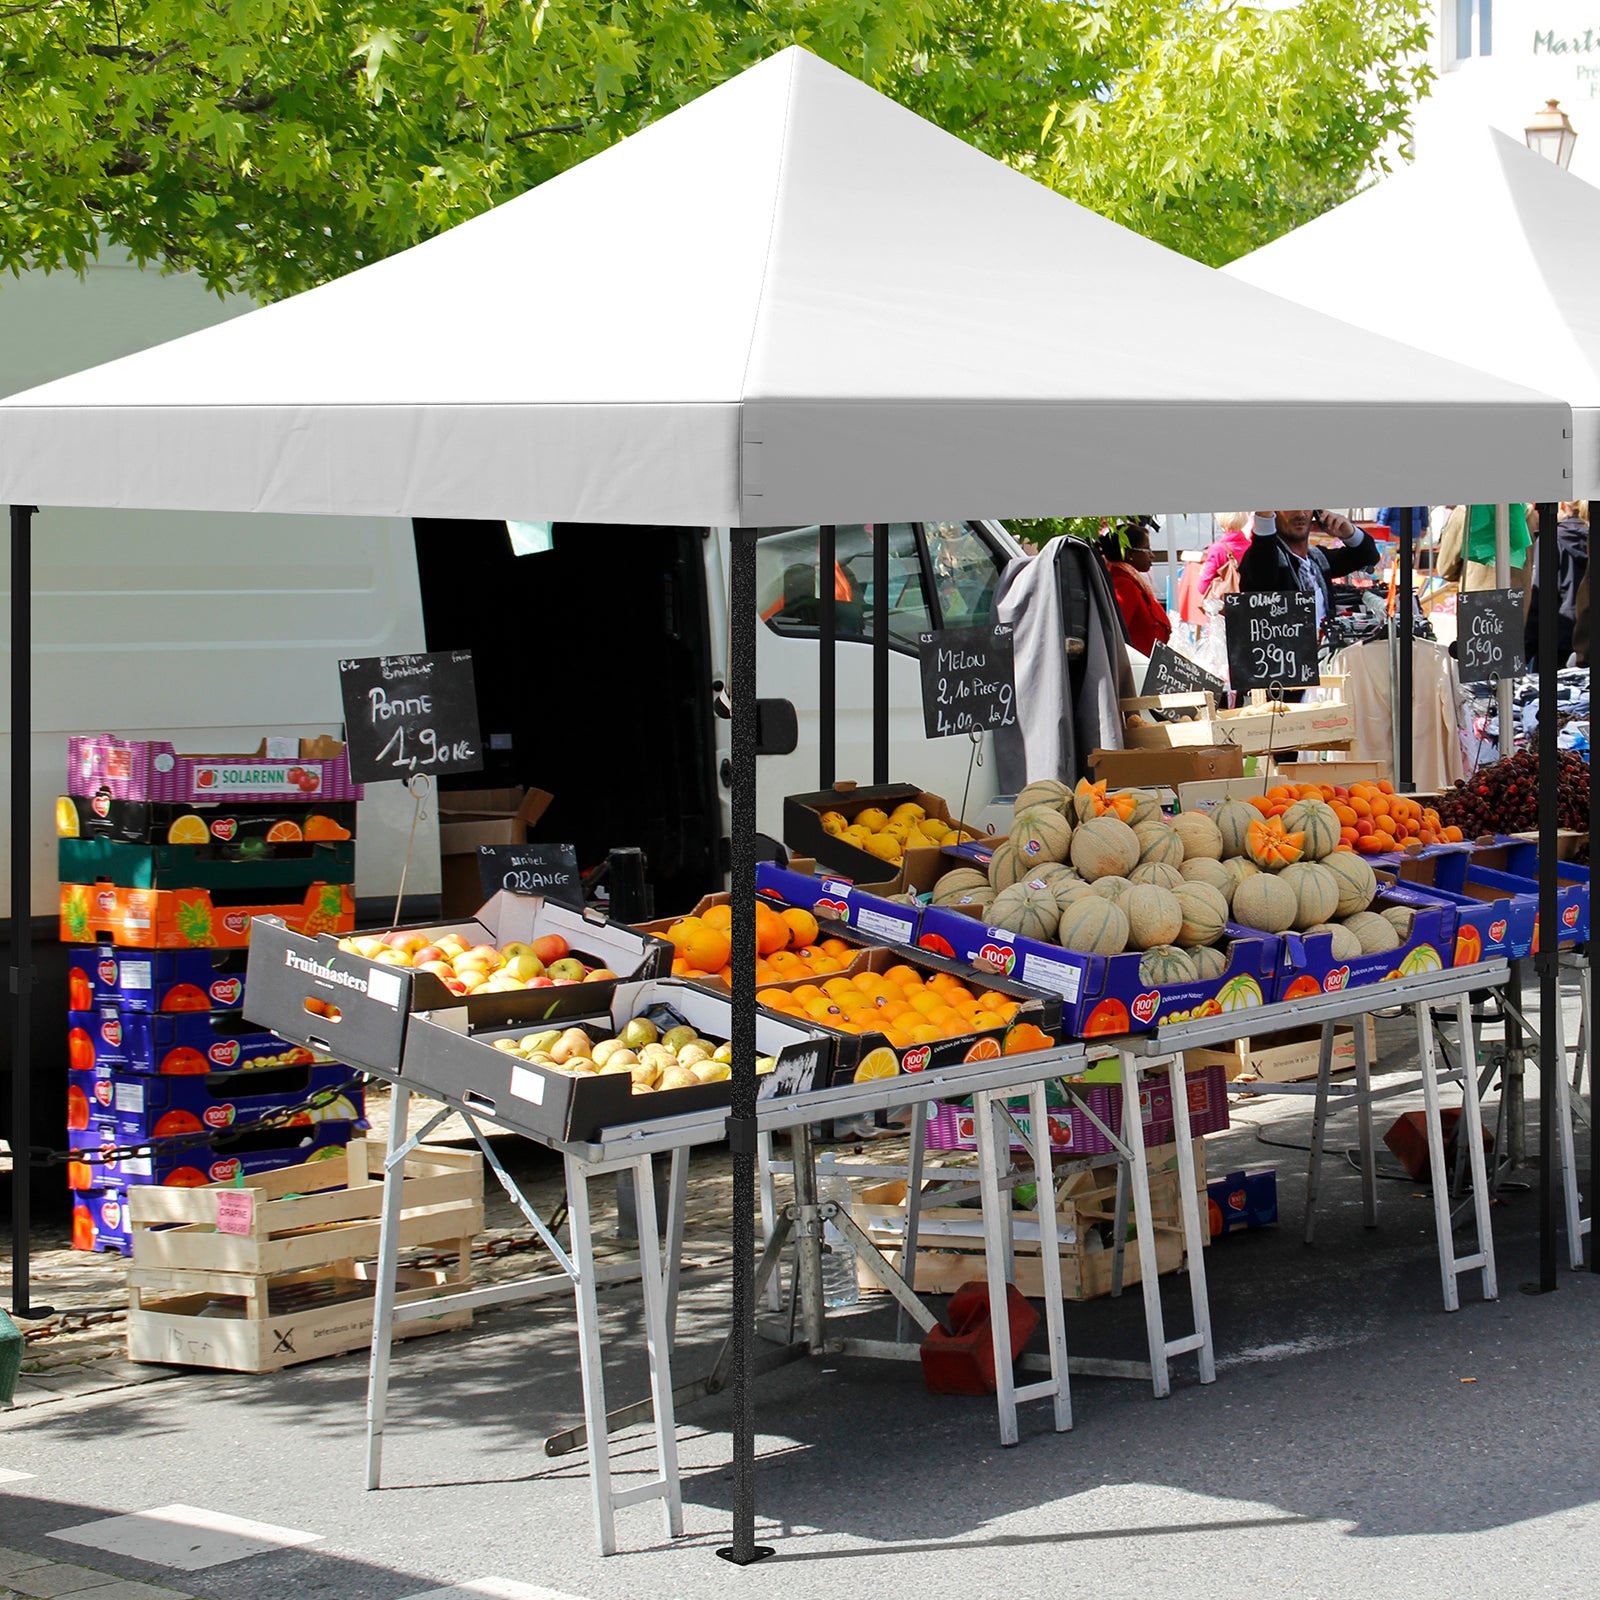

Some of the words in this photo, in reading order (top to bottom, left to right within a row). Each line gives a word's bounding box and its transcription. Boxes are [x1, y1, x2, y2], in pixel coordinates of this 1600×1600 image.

[938, 648, 986, 672] MELON
[222, 769, 285, 783] SOLARENN
[503, 870, 569, 889] ORANGE
[285, 949, 368, 993] Fruitmasters
